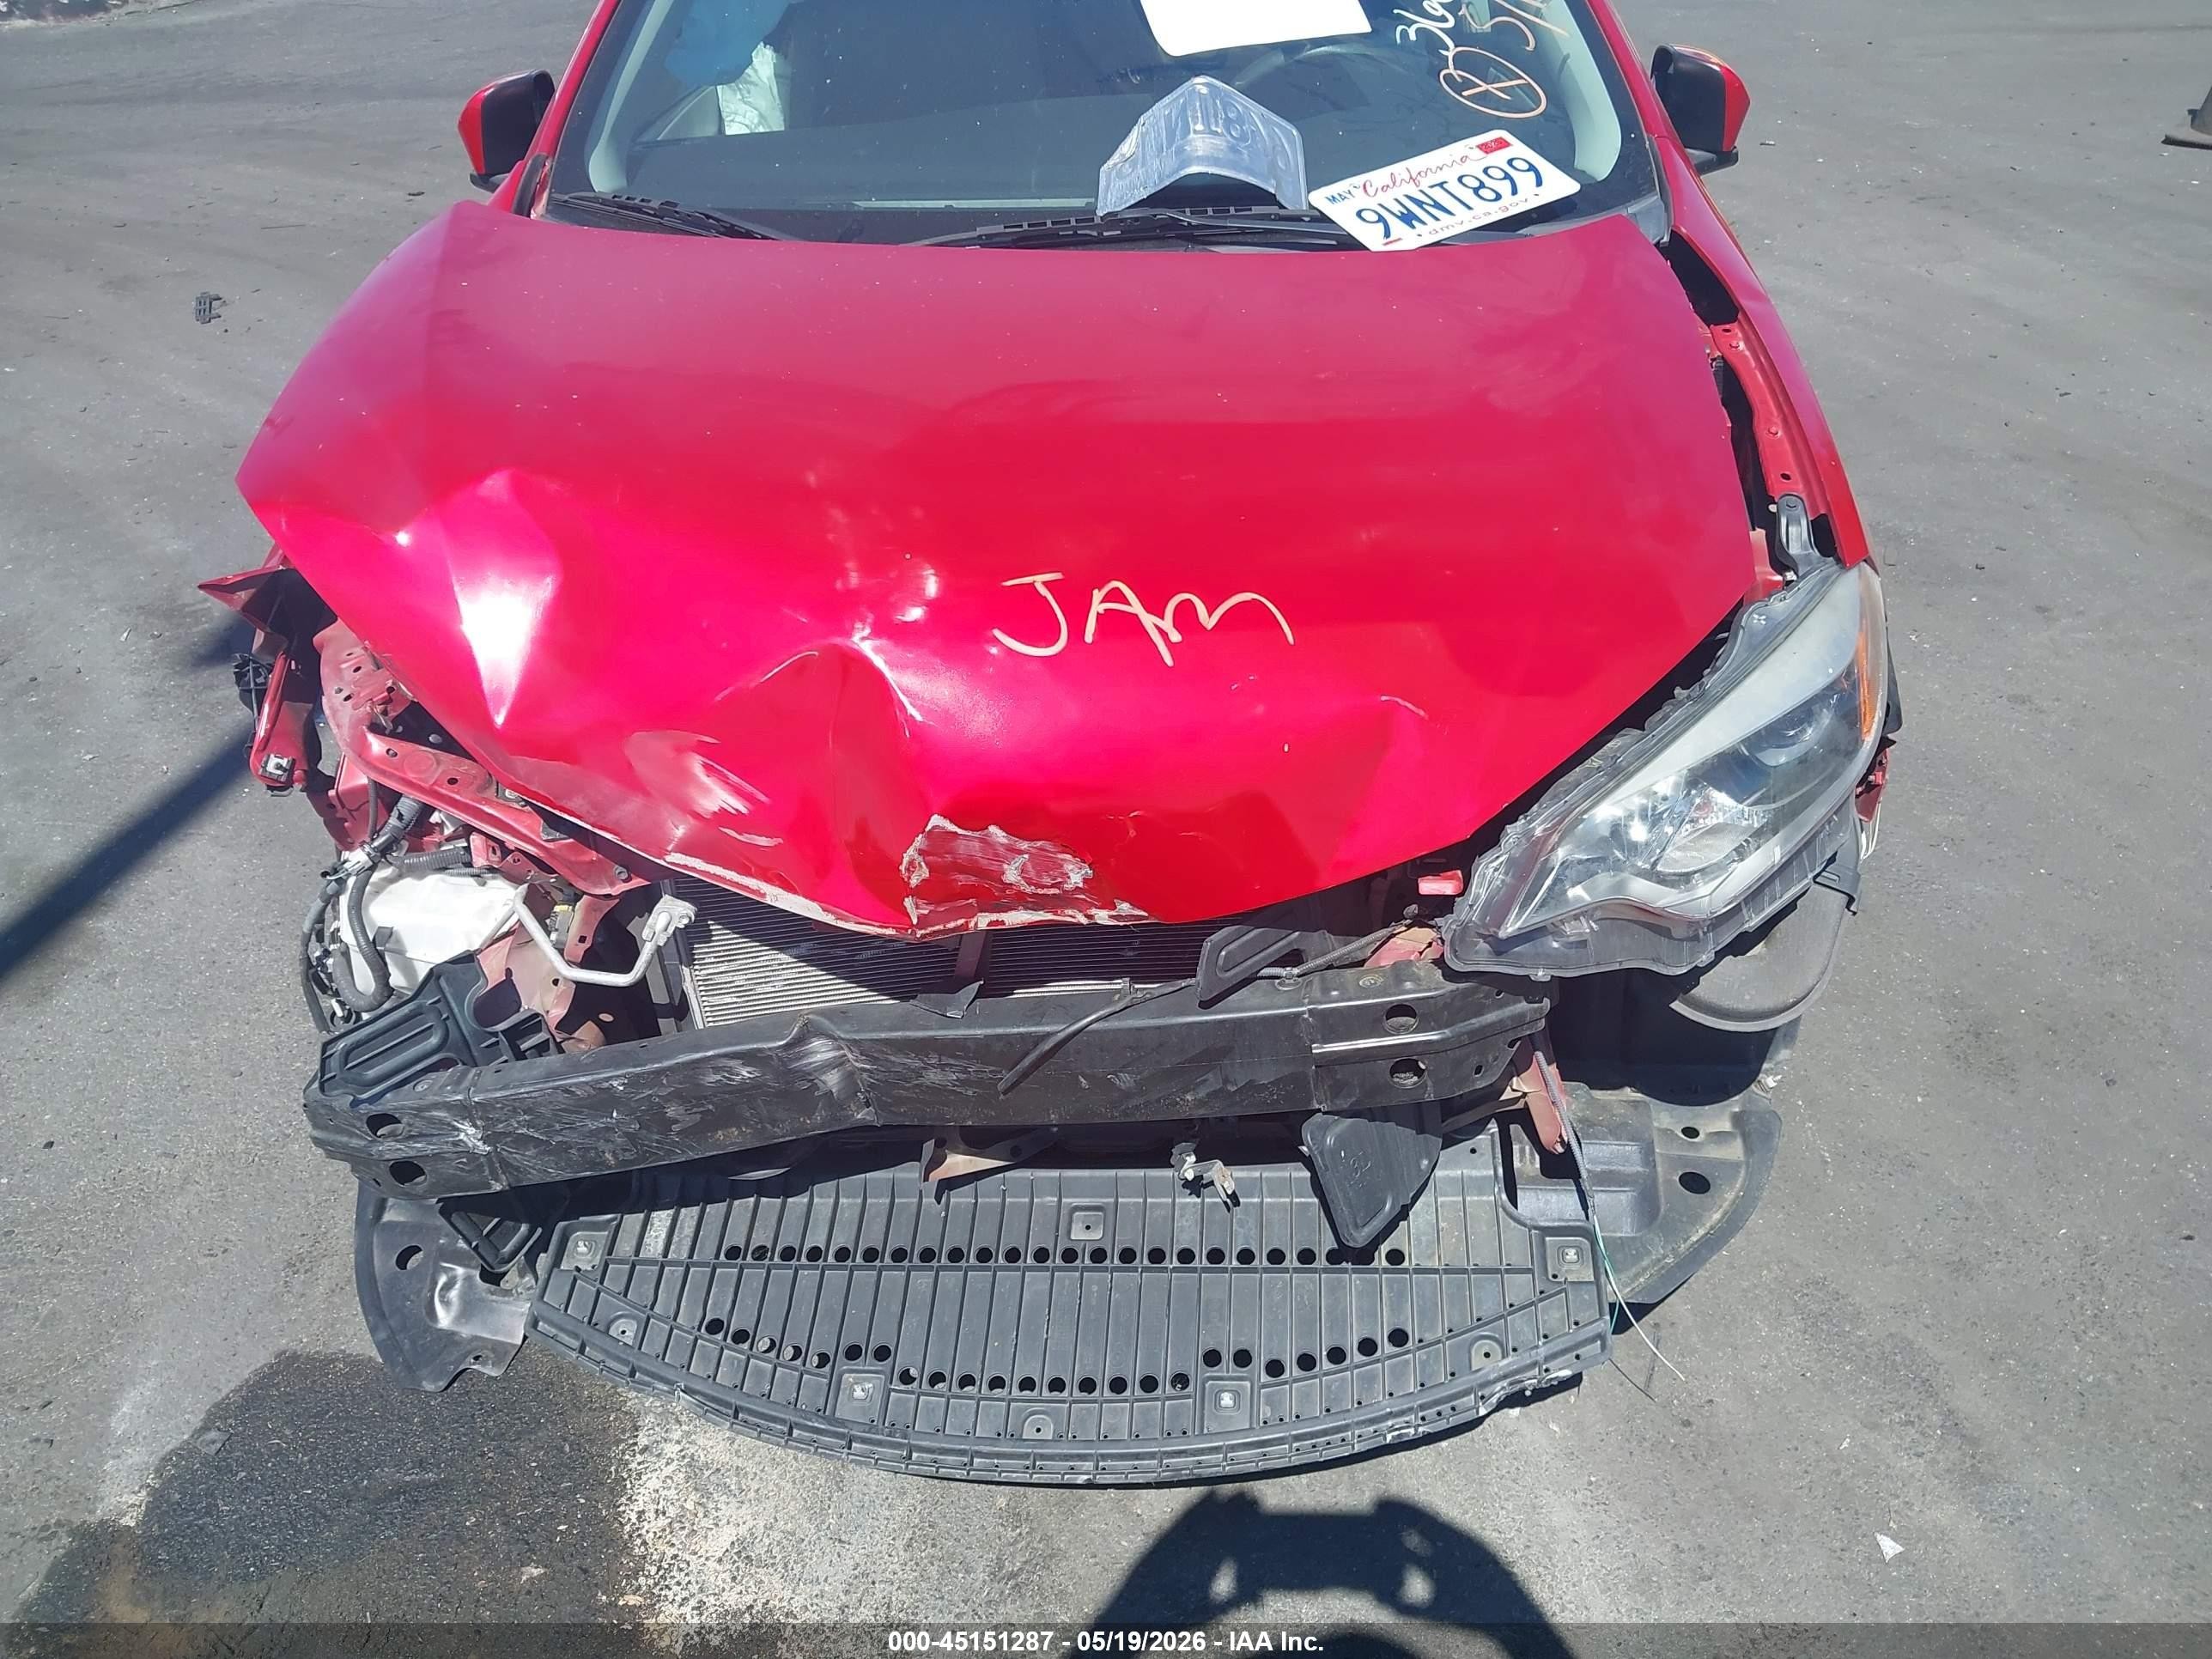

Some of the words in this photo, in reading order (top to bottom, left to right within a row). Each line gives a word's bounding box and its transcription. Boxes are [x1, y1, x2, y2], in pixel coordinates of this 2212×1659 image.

[1327, 190, 1353, 206] MAY
[1362, 149, 1487, 198] California
[1355, 157, 1543, 240] 9WNT899
[1428, 196, 1530, 237] dmv.ca.gov
